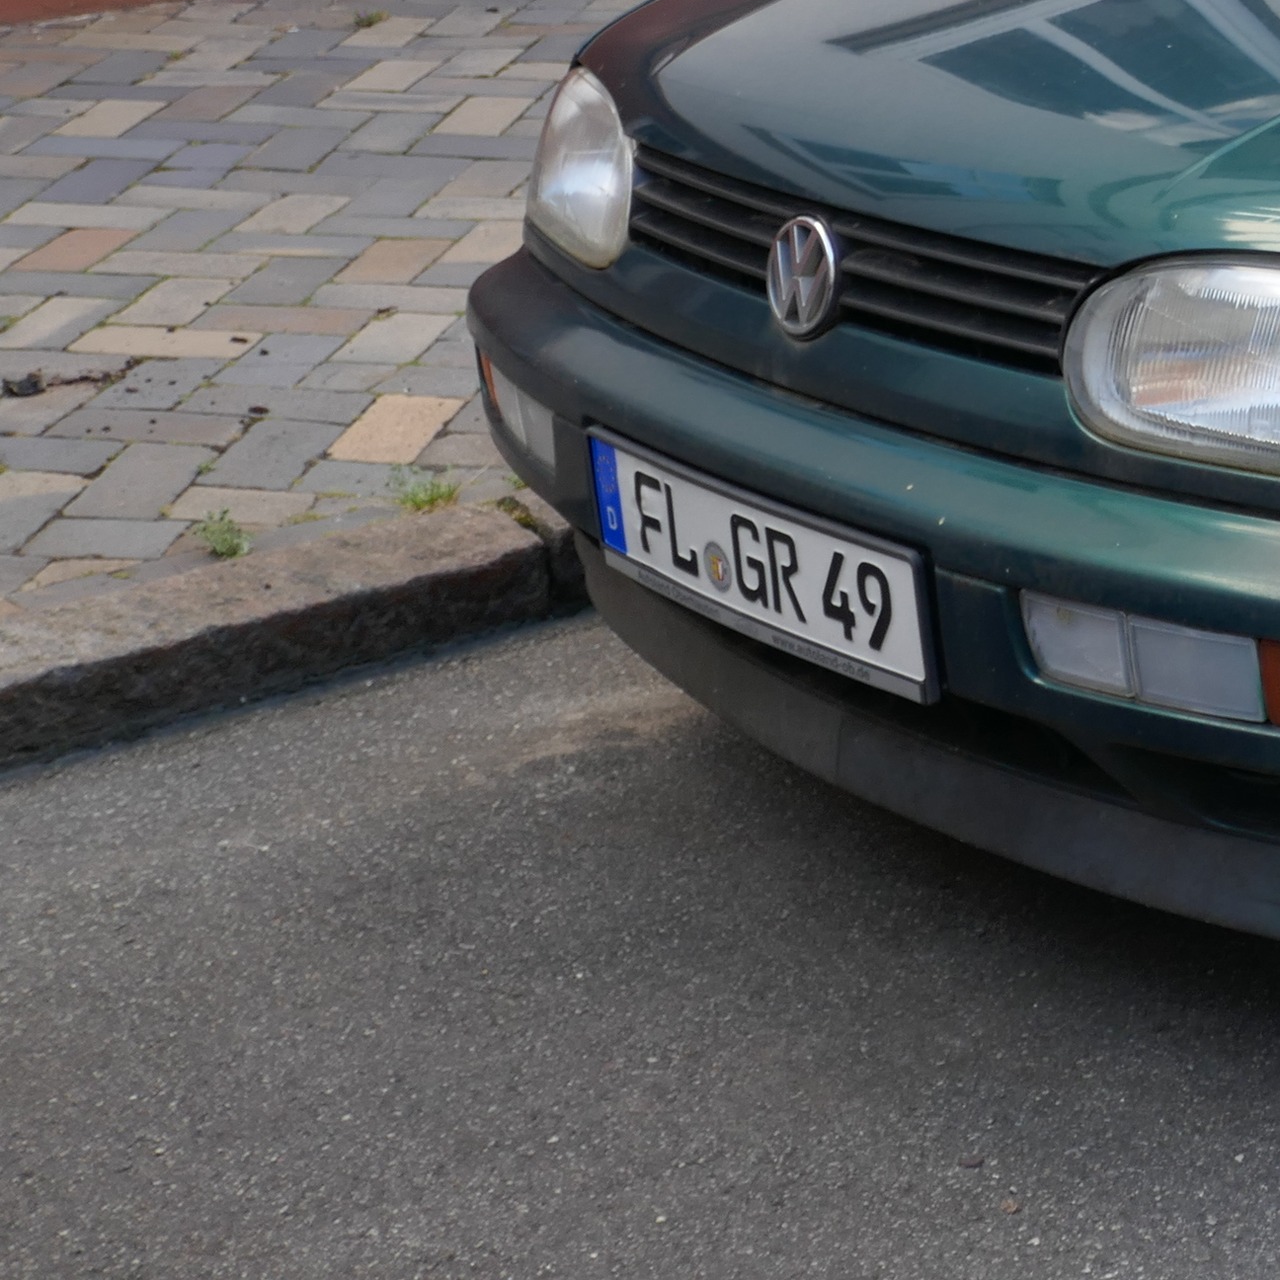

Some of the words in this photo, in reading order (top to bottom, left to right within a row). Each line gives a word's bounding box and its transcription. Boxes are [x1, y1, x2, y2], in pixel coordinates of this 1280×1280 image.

[607, 505, 619, 531] D
[634, 470, 699, 578] FL
[730, 513, 808, 624] GR
[822, 551, 892, 652] 49
